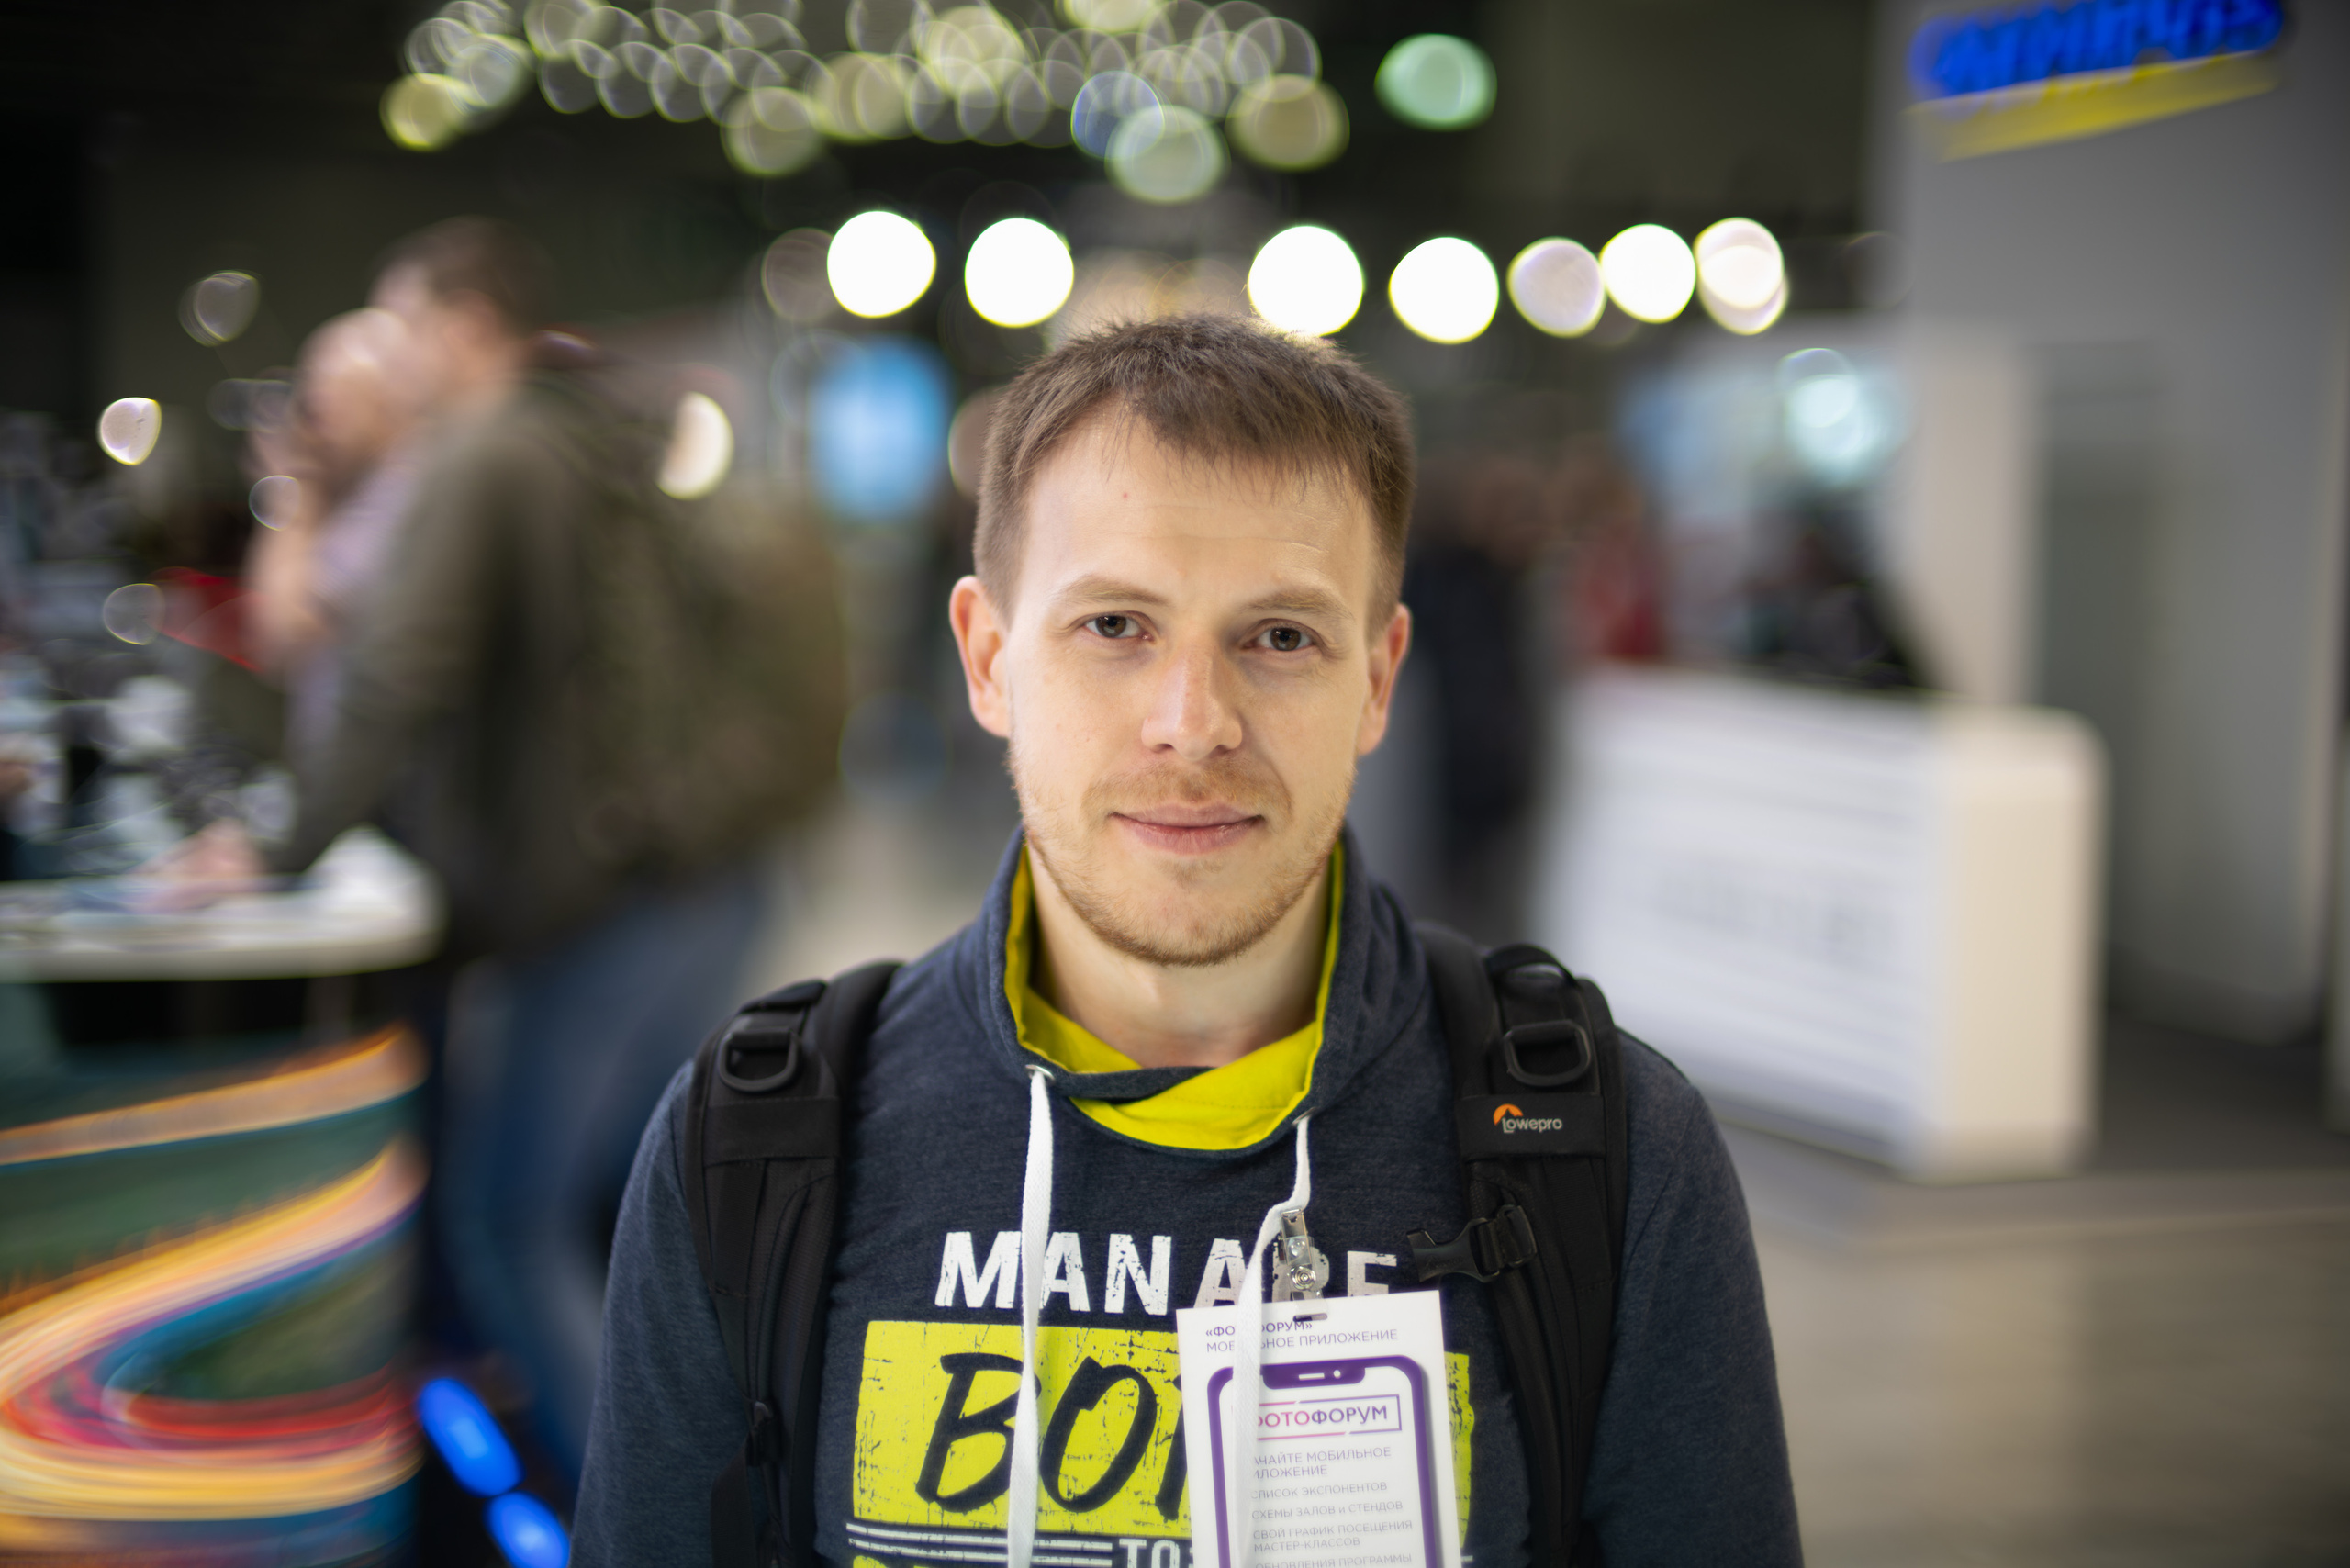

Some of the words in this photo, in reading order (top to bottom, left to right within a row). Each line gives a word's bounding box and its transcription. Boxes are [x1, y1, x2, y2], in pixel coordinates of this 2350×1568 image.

[1502, 1117, 1562, 1133] Lowepro
[1205, 1321, 1313, 1337] «ФООРУМ»
[1299, 1329, 1398, 1346] ПРИЛОЖЕНИЕ
[1307, 1447, 1392, 1462] МОБИЛЬНОЕ
[1302, 1482, 1388, 1496] ЭКСПОНЕНТОВ
[1252, 1508, 1292, 1520] СХЕМЫ
[1297, 1506, 1336, 1516] ЗАЛОВ
[1348, 1501, 1404, 1513] СТЕНДОВ
[1253, 1528, 1285, 1540] СВОЙ
[1289, 1526, 1334, 1538] ГРАФИК
[1338, 1520, 1413, 1534] ПОСЕЩЕНИЯ
[1254, 1537, 1360, 1553] МАСТЕР-КЛАССОВ
[1338, 1553, 1412, 1567] ПРОГРАММЫ
